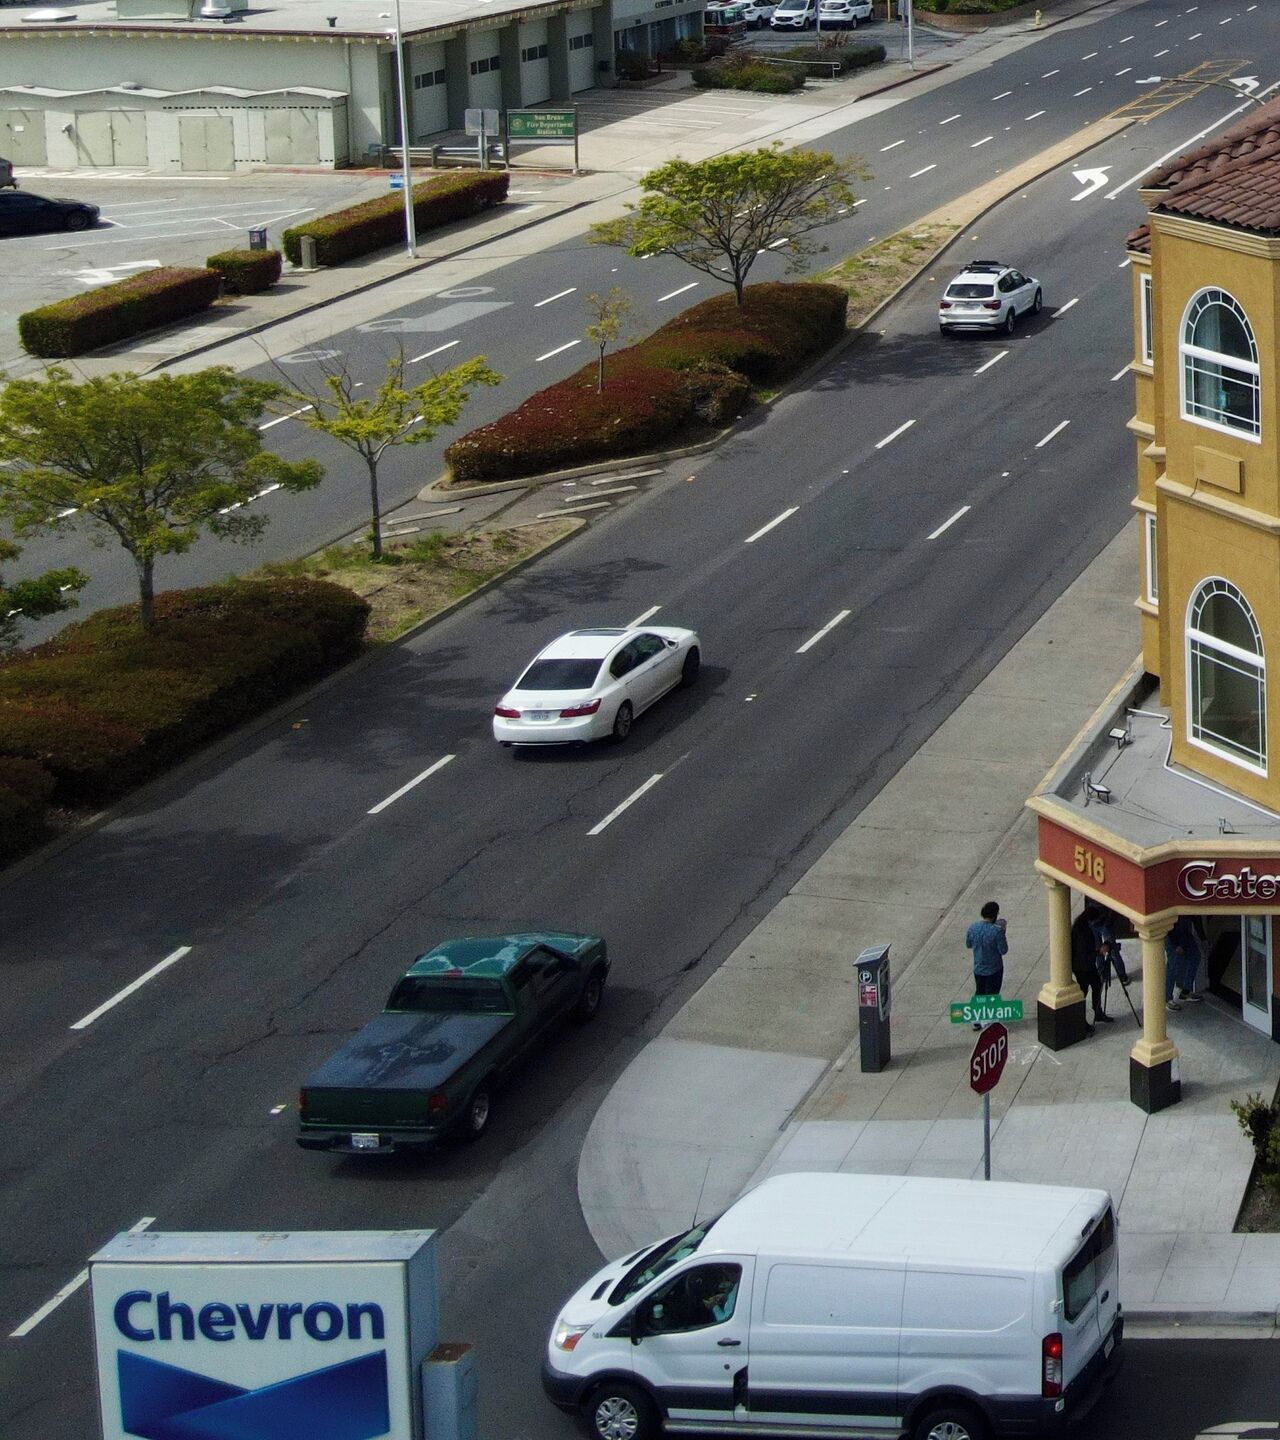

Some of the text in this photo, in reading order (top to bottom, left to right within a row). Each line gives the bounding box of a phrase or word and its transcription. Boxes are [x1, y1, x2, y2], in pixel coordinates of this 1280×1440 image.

[540, 121, 574, 129] Department
[1074, 844, 1105, 884] 516
[963, 1005, 1012, 1022] Sylvan
[972, 1035, 1006, 1082] STOP
[113, 1290, 385, 1342] Chevron
